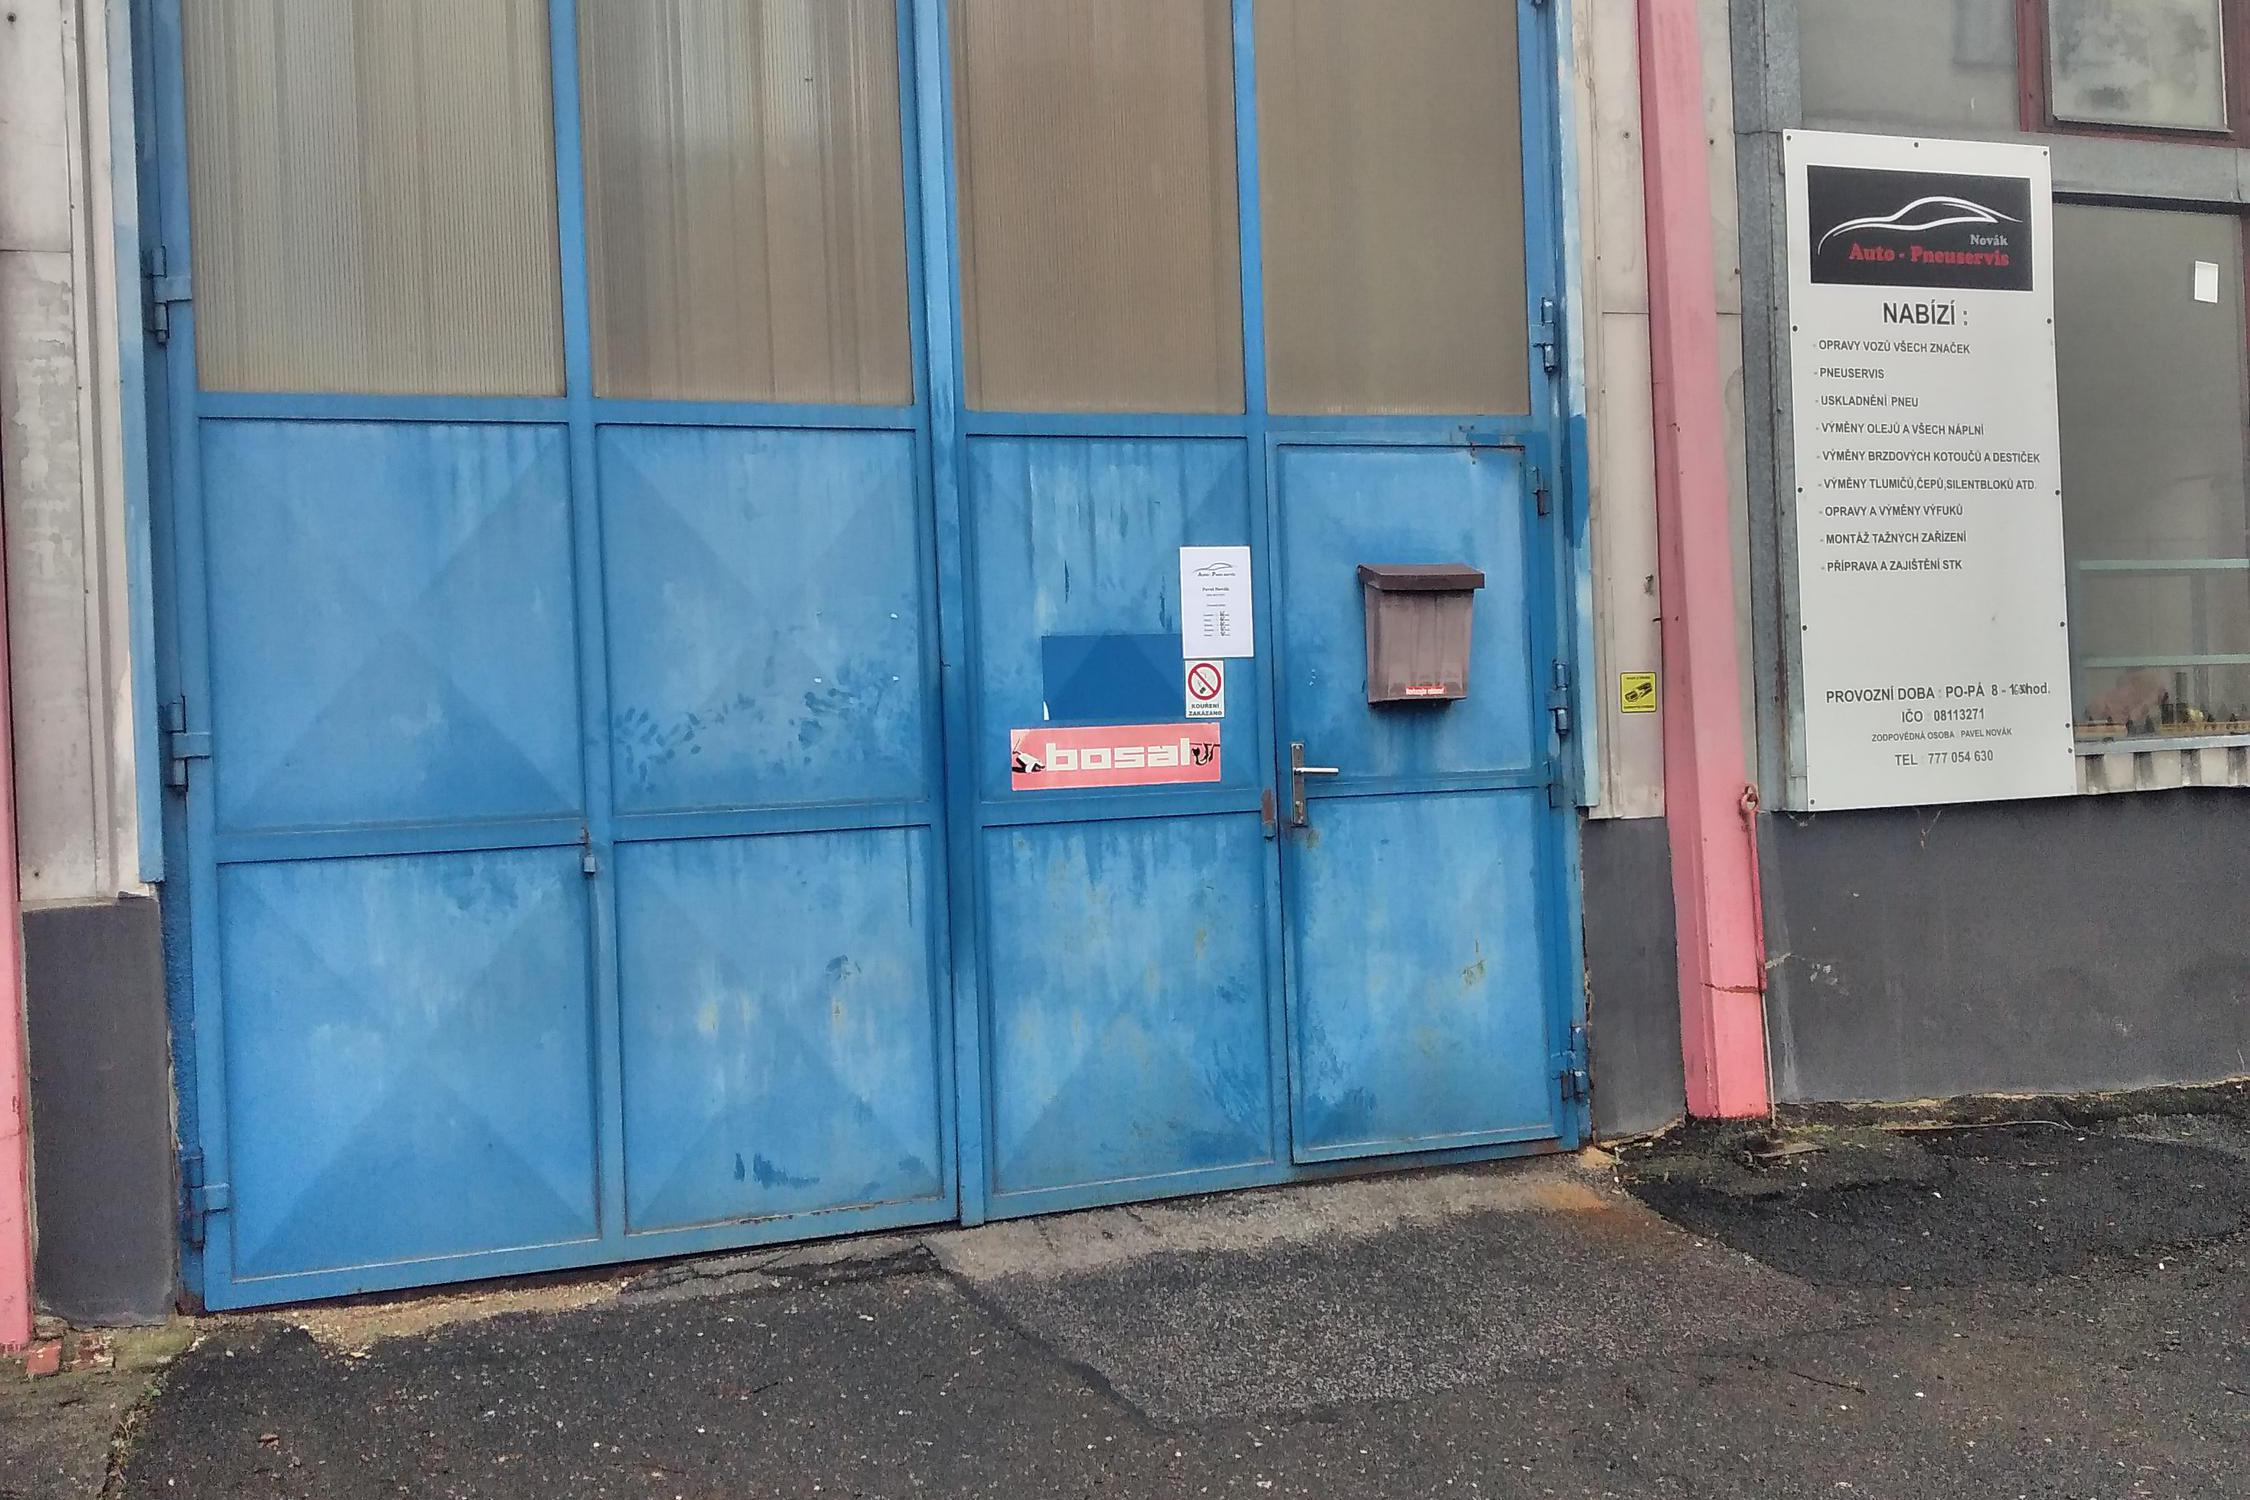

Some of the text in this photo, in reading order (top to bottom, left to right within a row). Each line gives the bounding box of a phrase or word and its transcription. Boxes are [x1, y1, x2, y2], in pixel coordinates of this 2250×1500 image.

[1970, 234, 2008, 246] Novák
[1849, 242, 1895, 261] Auto
[1910, 245, 2010, 267] Pneuservis
[1884, 300, 1956, 325] NABÍZÍ
[1819, 340, 1970, 354] OPRAVY VOZŮ VŠECH ZNAČEK
[1820, 368, 1884, 379] PNEUSERVIS
[1821, 395, 1919, 407] USKLADNĚNÍ PNEU
[1822, 421, 1984, 435] VÝMĚNY OLEJŮ A VŠECH NÁPLNÍ
[1822, 449, 2040, 463] VÝMĚNY BRZDOVÝCH KOTOUČŮ A DESTIČEK
[1824, 477, 1867, 490] VÝMĚNY
[1825, 503, 1963, 517] OPRAVY A VÝMĚNY VÝFUKŮ
[1826, 531, 1966, 544] MONTÁŽ TAŽNÝCH ZAŘÍZENÍ
[1827, 558, 1962, 572] PŘÍPRAVA A ZAJIŠTĚNÍ STK
[1826, 685, 1894, 703] PROVOZNÍ
[1898, 687, 1935, 700] DOBA
[1946, 682, 1985, 698] PO-PÁ
[1992, 684, 1998, 696] 8
[1902, 708, 1984, 723] IČO 08113271
[1872, 726, 2012, 742] ZODPOVĚDNÁ OSOBA PAVEL NOVÁK
[1046, 738, 1190, 771] bosal
[1928, 752, 1948, 764] 777
[1951, 751, 1971, 763] 054
[1974, 750, 1994, 762] 630
